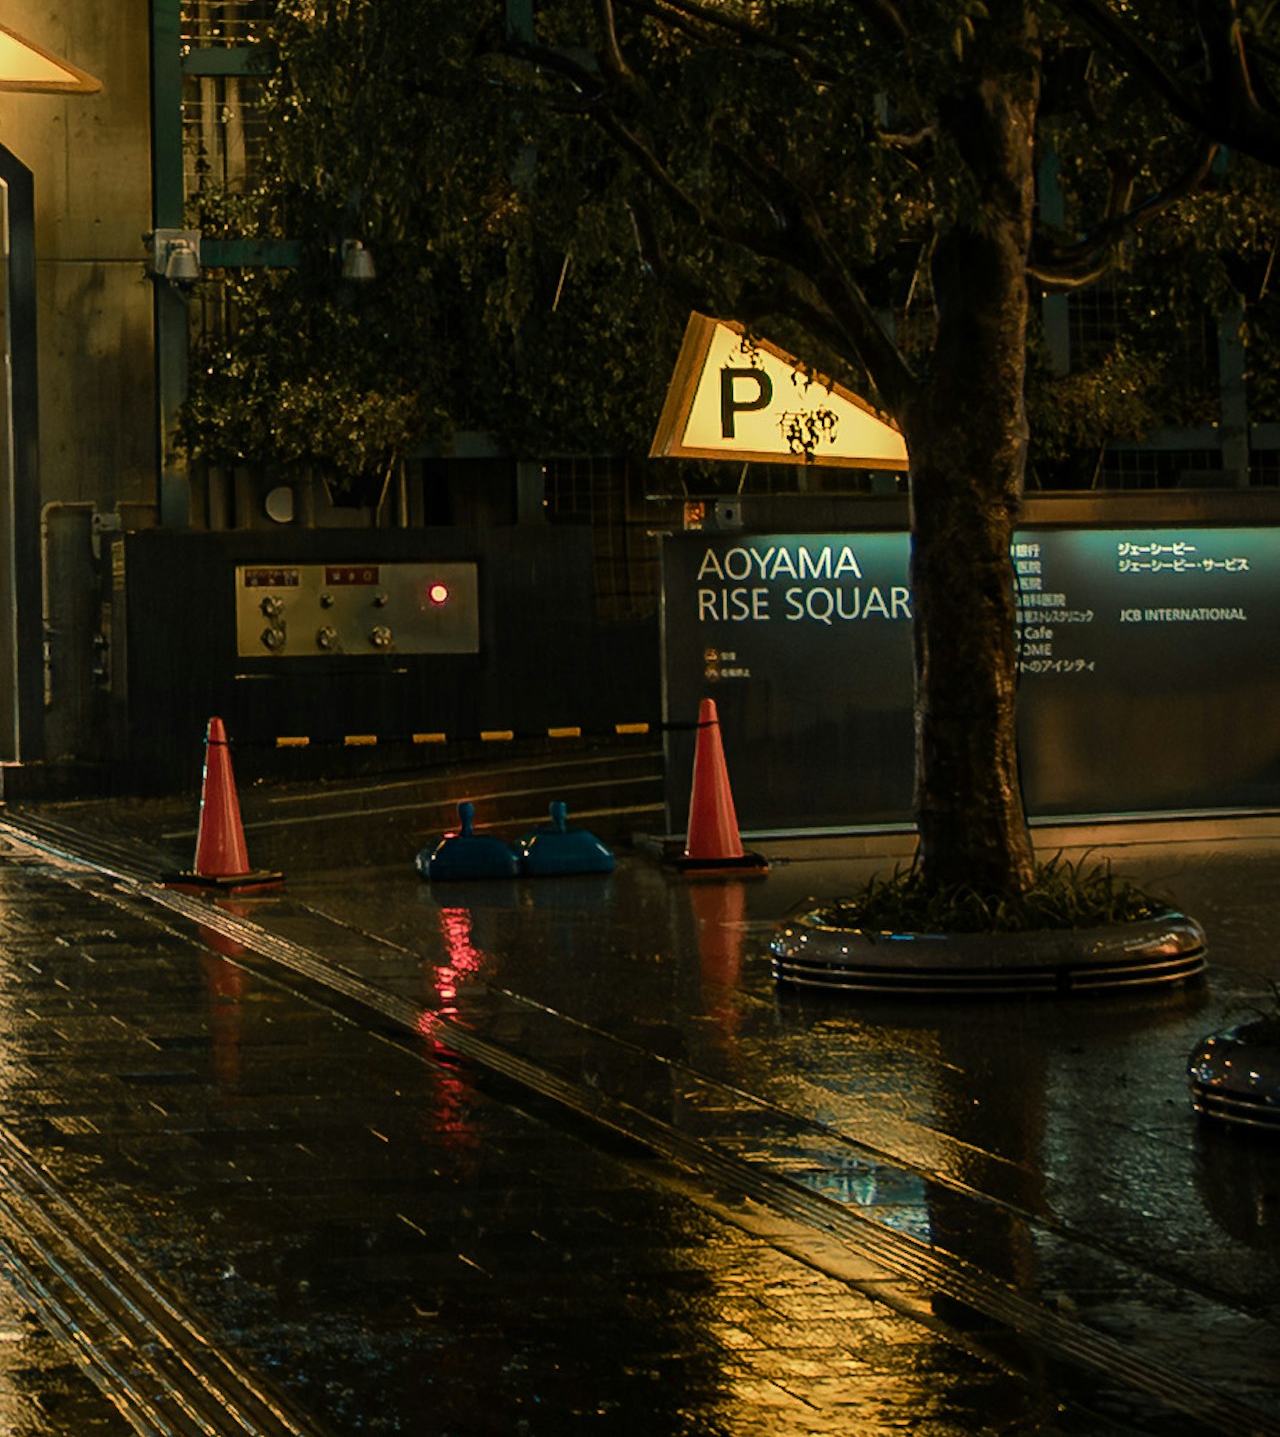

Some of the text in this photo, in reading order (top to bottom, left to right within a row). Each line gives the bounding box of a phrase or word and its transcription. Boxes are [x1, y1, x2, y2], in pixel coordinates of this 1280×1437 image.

[719, 367, 774, 439] P
[697, 546, 863, 581] AOYAMA
[698, 586, 912, 625] RISE SQUAR
[1119, 608, 1248, 622] JCB INTERNATIONAL
[1024, 626, 1054, 640] Cafe
[1014, 660, 1096, 673] トのアイシティ
